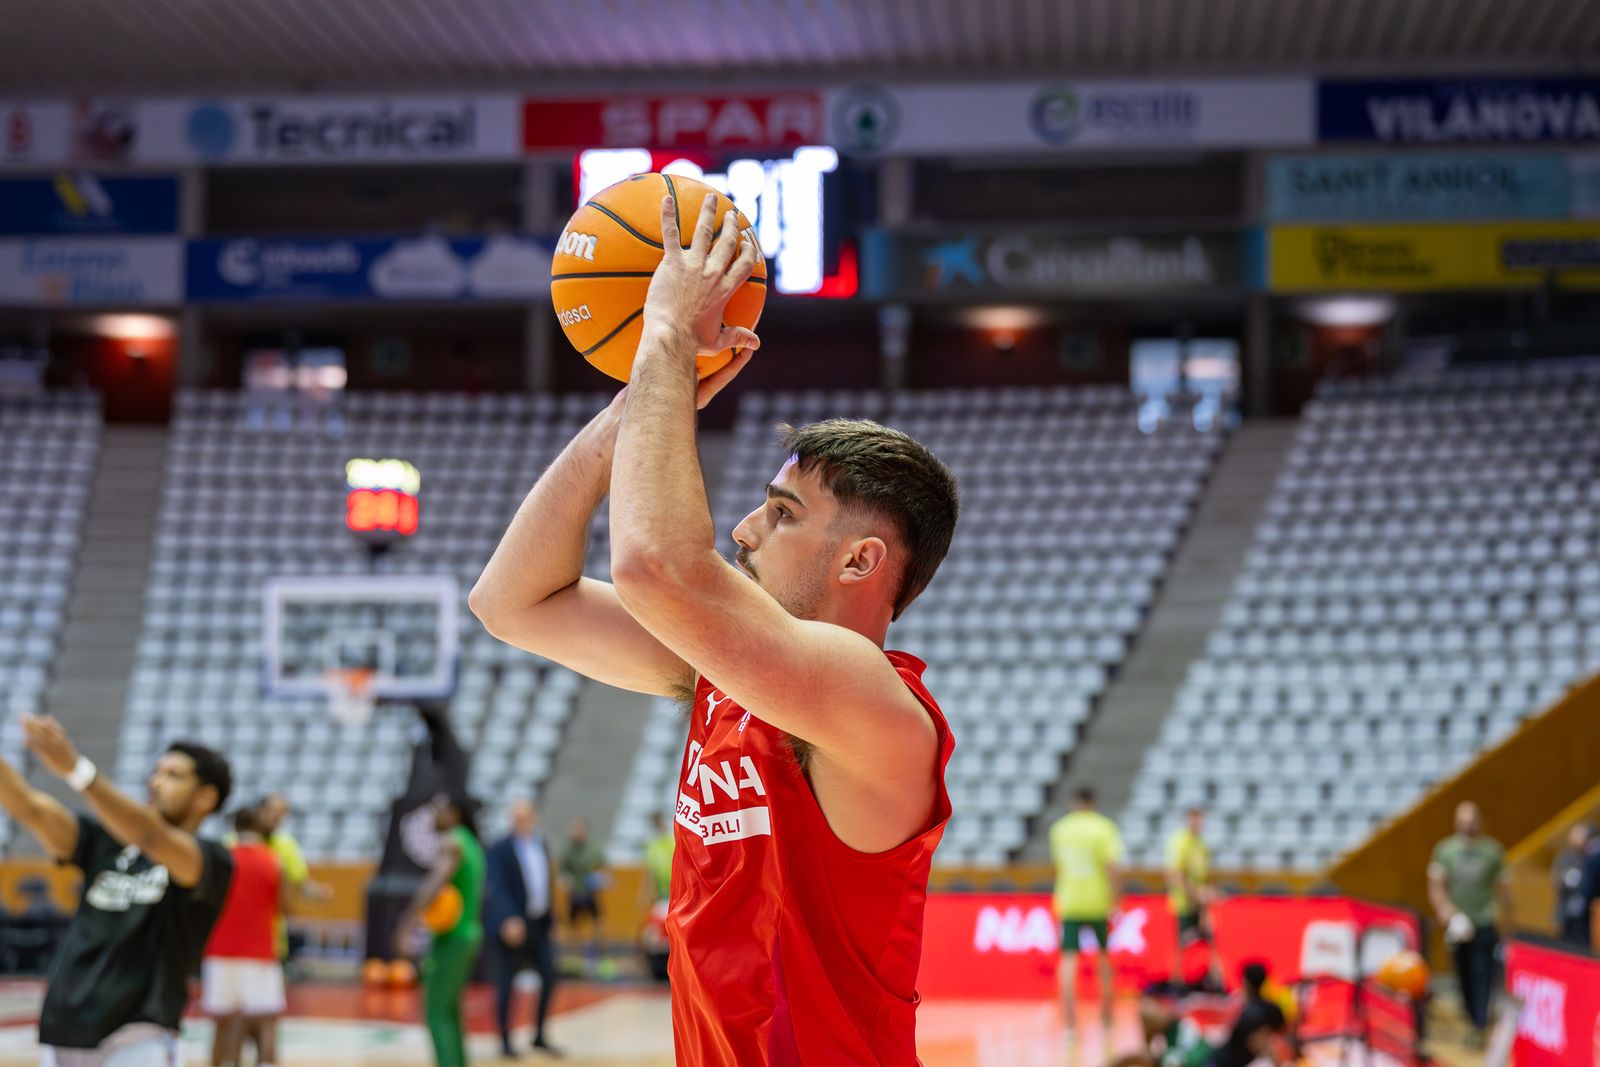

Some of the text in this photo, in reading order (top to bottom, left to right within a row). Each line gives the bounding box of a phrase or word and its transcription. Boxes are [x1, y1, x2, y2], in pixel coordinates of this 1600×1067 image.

[248, 103, 477, 153] Tecnical
[602, 98, 814, 147] SPAR
[1367, 96, 1600, 138] VILANOVA
[989, 237, 1212, 284] CaixaBank
